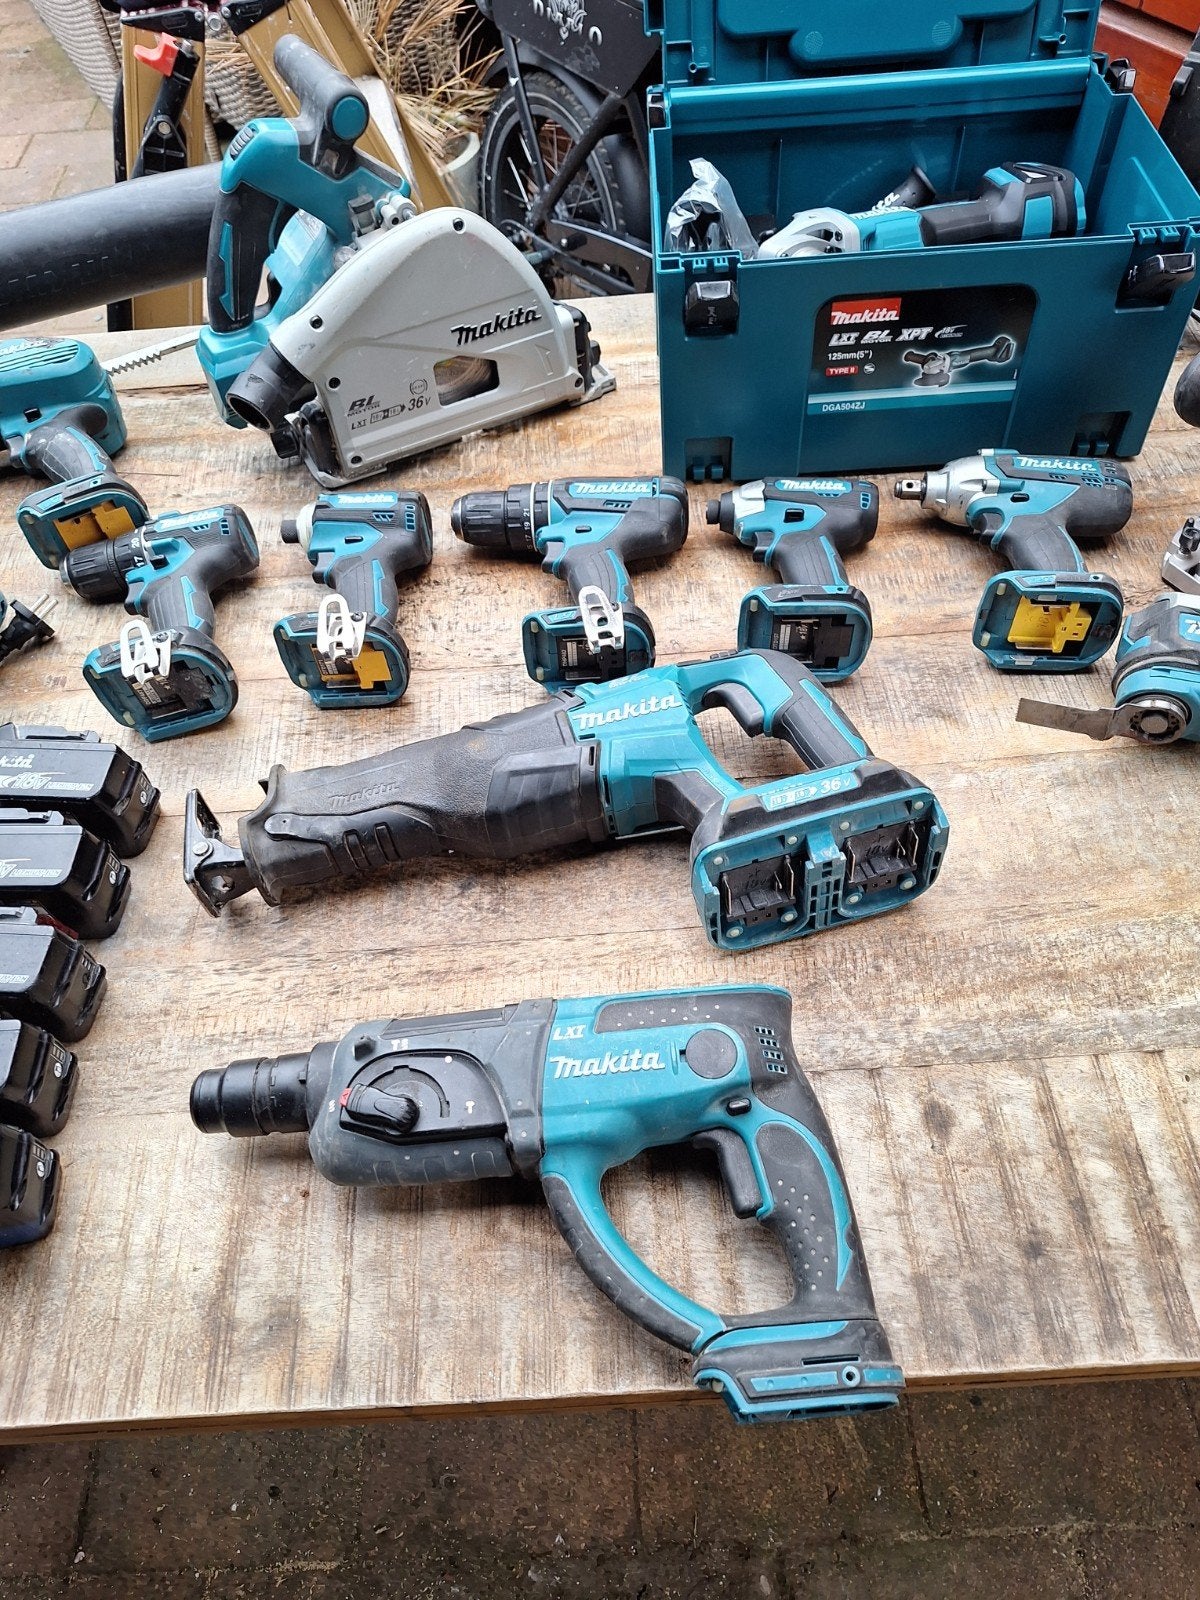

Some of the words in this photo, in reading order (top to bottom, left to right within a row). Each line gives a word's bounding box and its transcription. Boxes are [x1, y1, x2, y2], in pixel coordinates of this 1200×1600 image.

[831, 307, 899, 325] makita
[450, 305, 542, 346] makita
[828, 332, 860, 346] LXT
[895, 326, 934, 342] XPT
[829, 367, 849, 375] TYPE
[822, 402, 866, 412] DGA504ZJ
[351, 418, 368, 430] LXT
[1016, 456, 1097, 471] makita
[576, 481, 652, 495] makita
[780, 479, 847, 491] makita
[337, 493, 396, 504] makita
[570, 694, 683, 731] makita
[553, 1024, 586, 1040] LXT
[549, 1048, 666, 1079] makita
